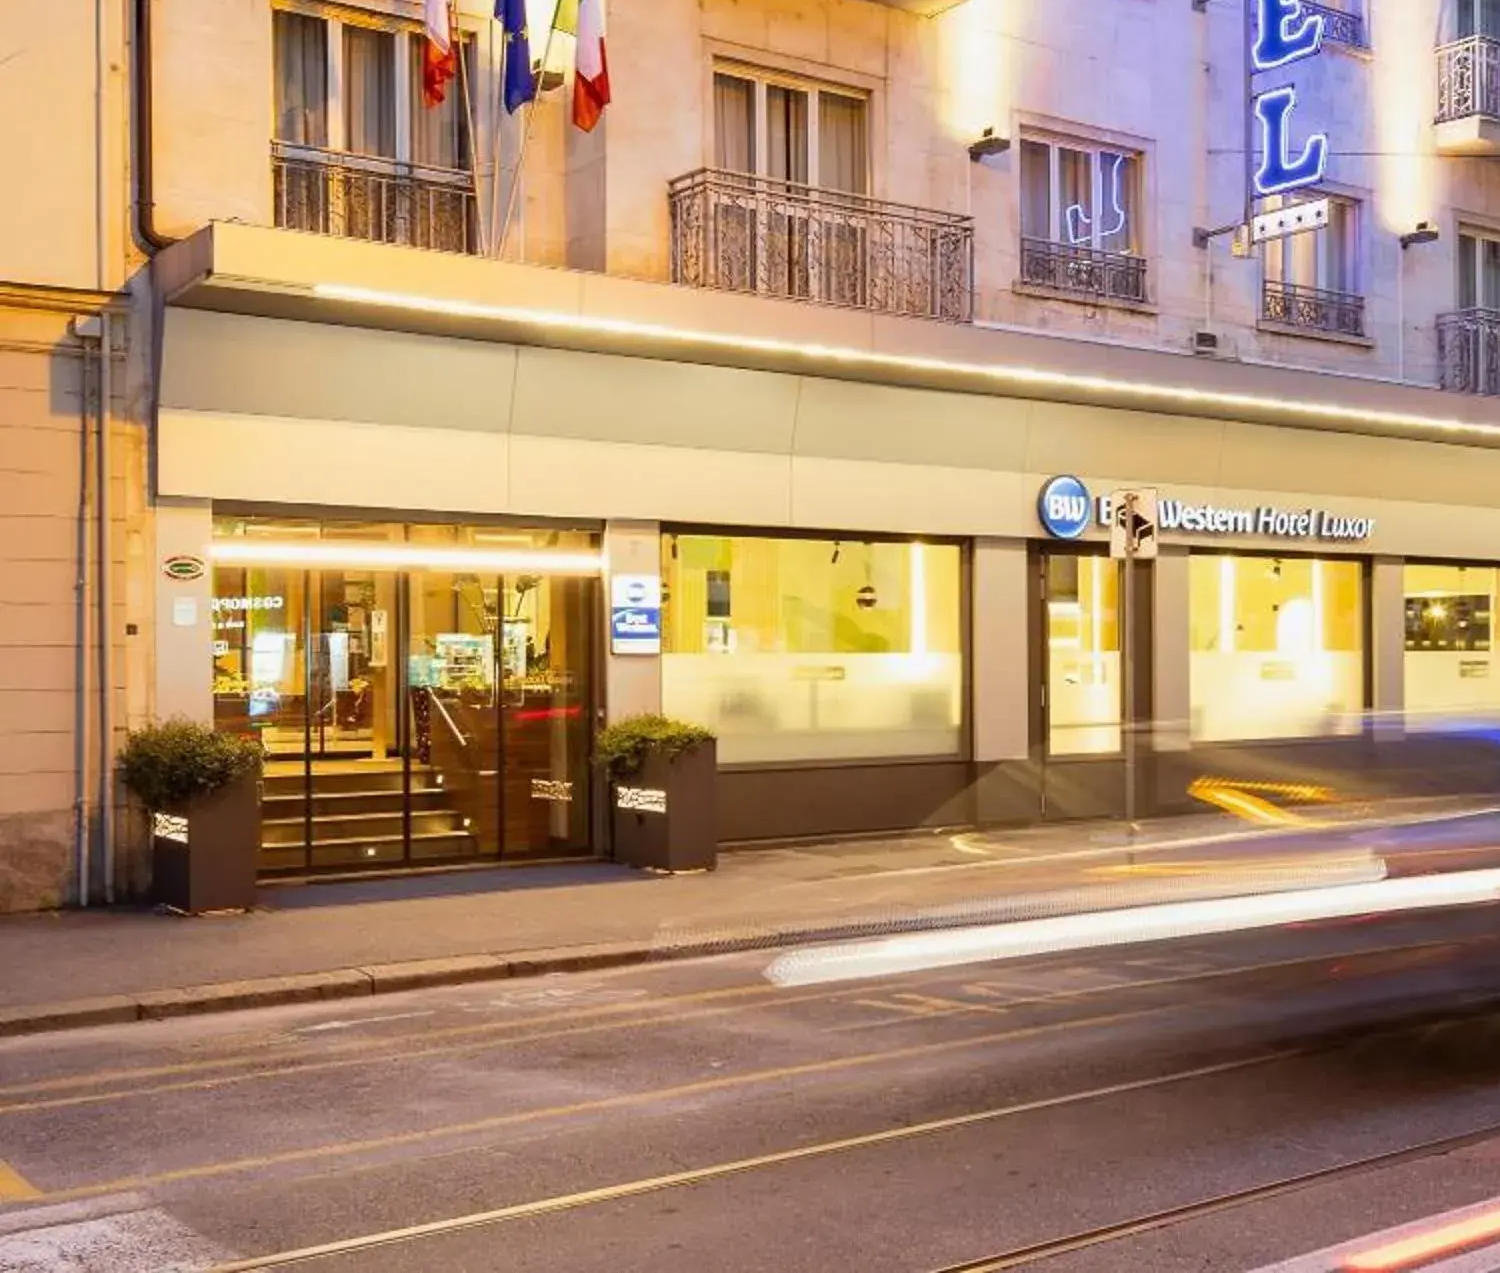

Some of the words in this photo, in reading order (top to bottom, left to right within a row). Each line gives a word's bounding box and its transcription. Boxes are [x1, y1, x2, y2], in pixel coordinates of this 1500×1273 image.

[1049, 495, 1085, 521] BW
[1158, 500, 1253, 533] Western
[1257, 507, 1316, 536] Hotel
[1320, 511, 1376, 538] Luxor
